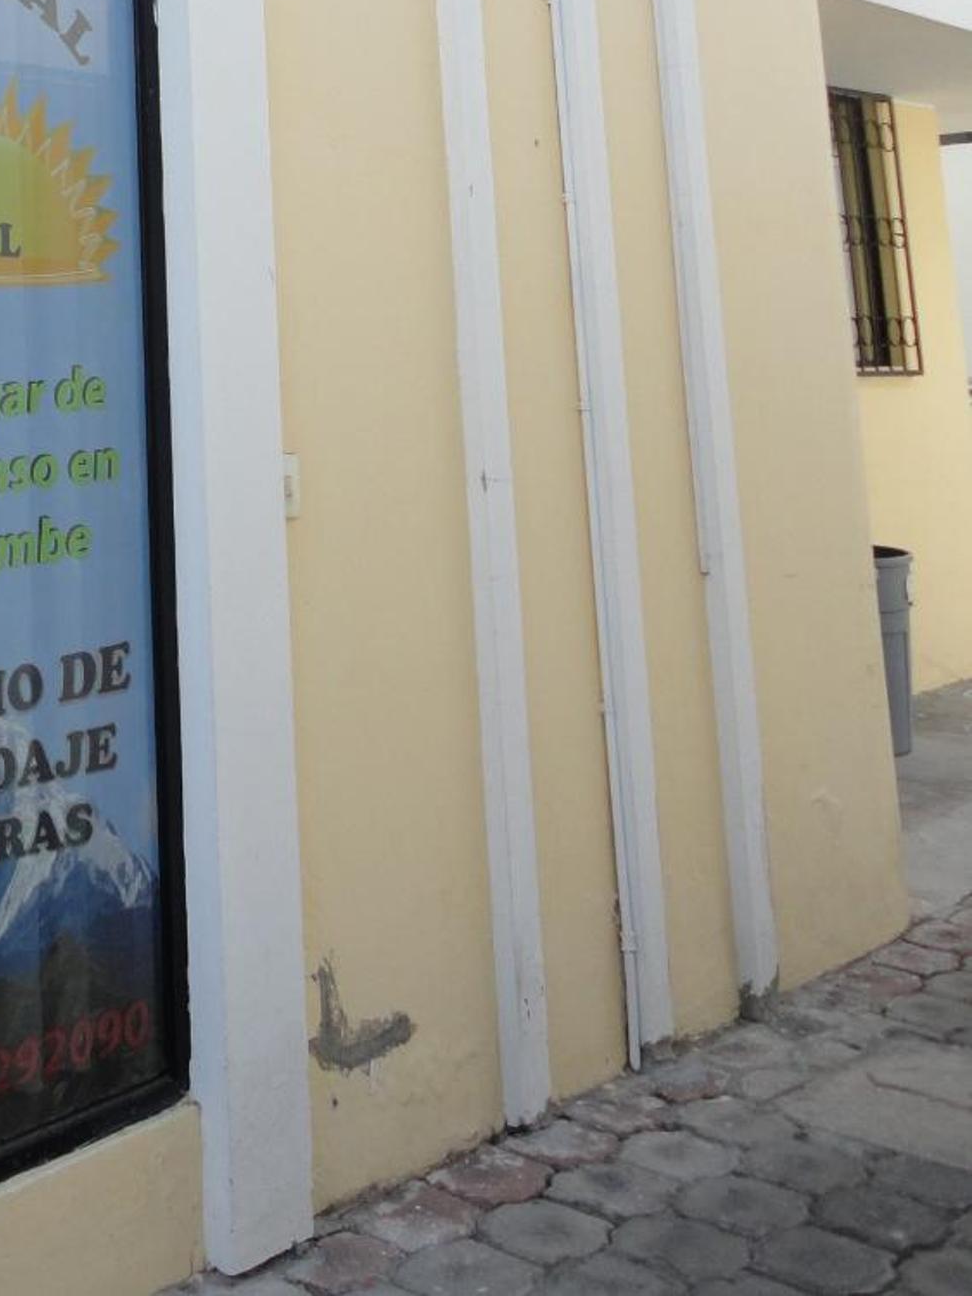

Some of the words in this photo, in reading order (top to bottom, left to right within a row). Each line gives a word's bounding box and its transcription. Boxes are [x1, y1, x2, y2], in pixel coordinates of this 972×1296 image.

[54, 366, 107, 409] de
[68, 444, 119, 484] en
[58, 641, 133, 705] DE
